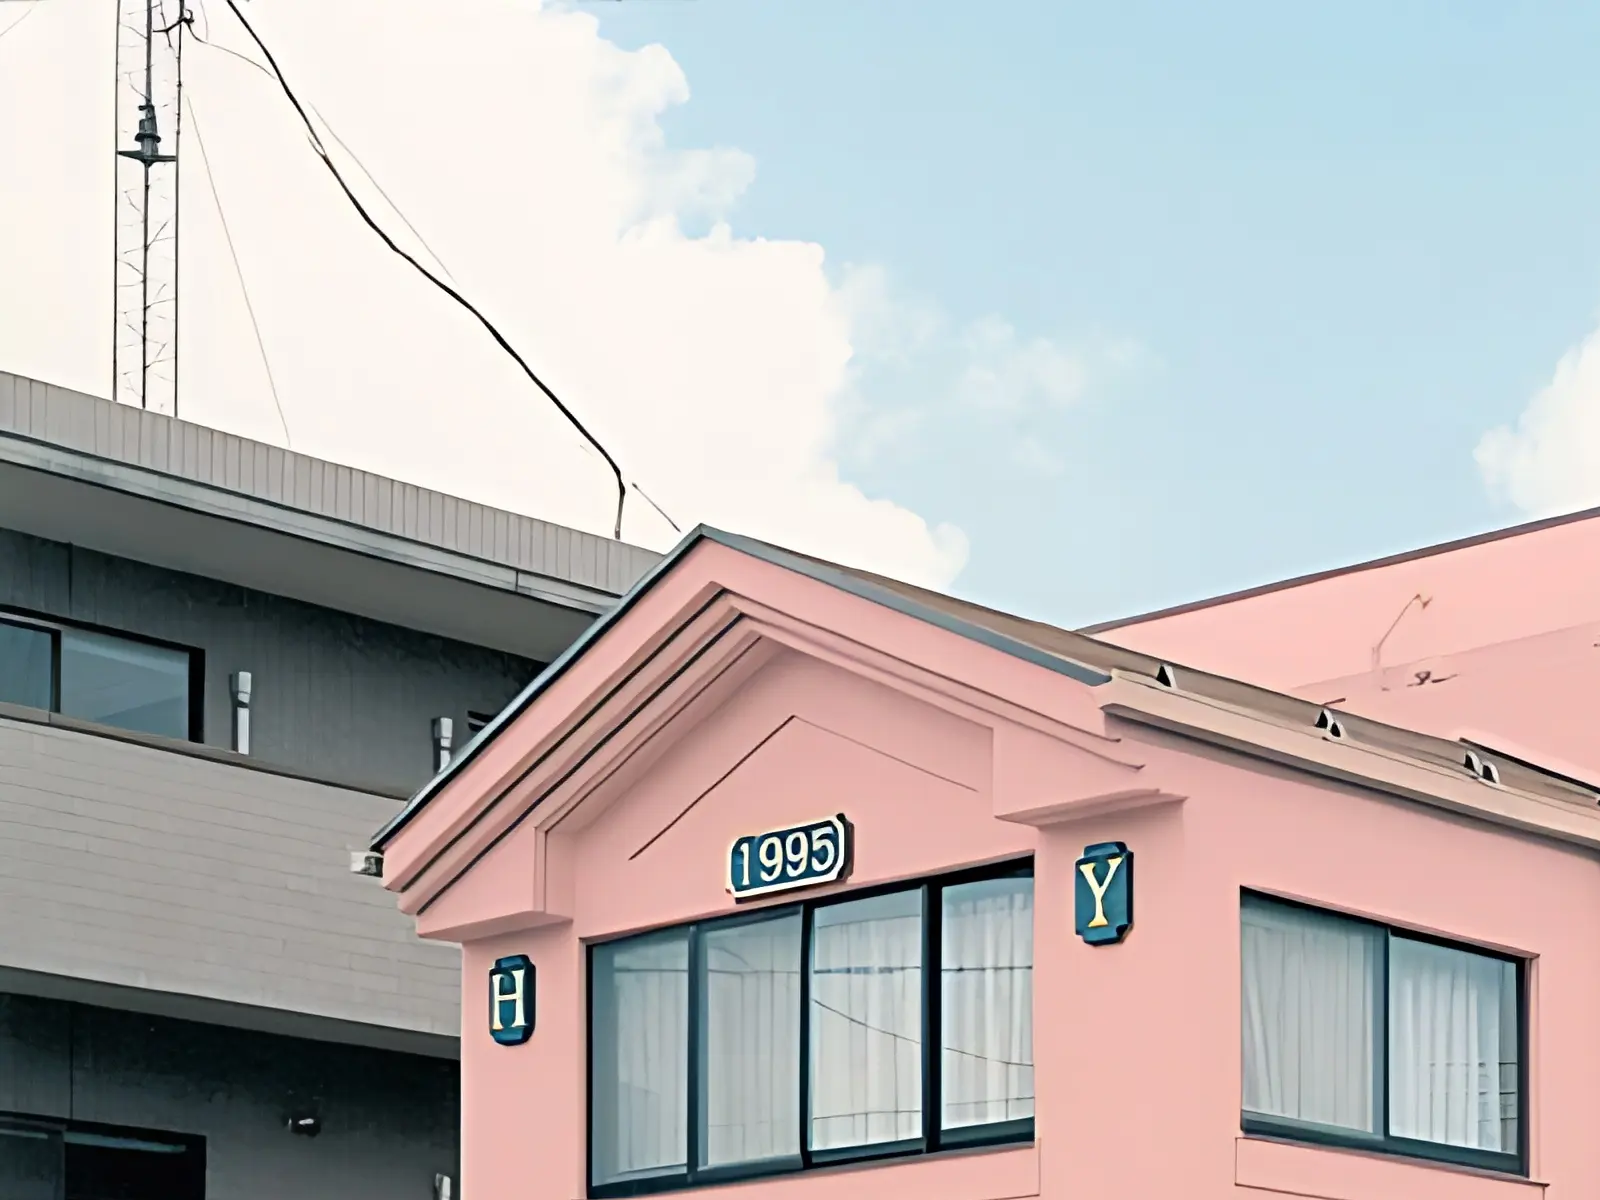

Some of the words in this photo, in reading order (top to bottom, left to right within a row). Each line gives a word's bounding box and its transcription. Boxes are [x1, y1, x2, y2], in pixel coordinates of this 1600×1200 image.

[740, 826, 835, 886] 1995
[1079, 856, 1124, 928] Y
[492, 968, 526, 1030] H
